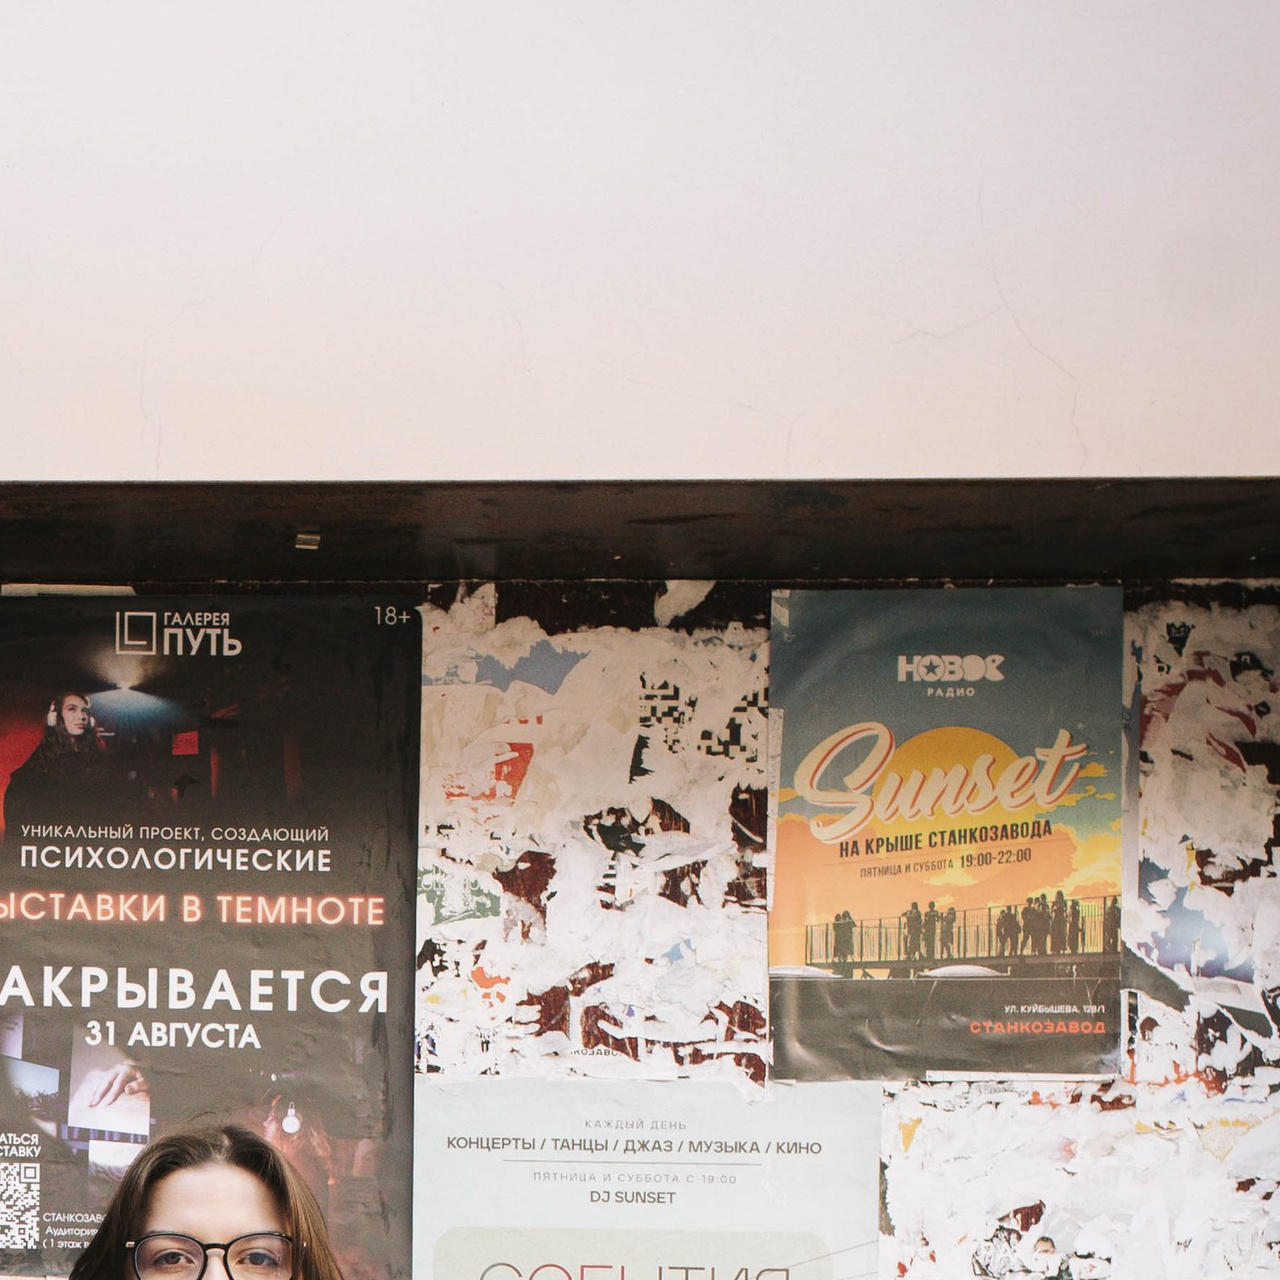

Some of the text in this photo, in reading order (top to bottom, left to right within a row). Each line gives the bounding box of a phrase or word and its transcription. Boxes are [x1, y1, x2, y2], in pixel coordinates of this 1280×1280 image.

[163, 612, 230, 626] ГАЛЕРЕЯ
[374, 606, 411, 626] 18+
[163, 628, 242, 656] ПУТЬ
[927, 687, 975, 698] РАДИО
[794, 722, 1087, 844] Sunset
[21, 823, 329, 844] УНИКАЛЬНЫЙ ПРОЕКТ, СОЗДАЮЩИЙ
[839, 820, 1052, 858] НА КРЫШЕ СТАНКОЗАВОДА
[20, 845, 331, 872] ПСИХОЛОГИЧЕСКИЕ
[860, 848, 1032, 879] ПЯТНИЦА И СУББОТА 19:00-22:00
[182, 894, 202, 922] В
[216, 896, 385, 926] ТЕМНОТЕ
[1004, 1005, 1019, 1014] УЛ.
[85, 1020, 261, 1049] 31 АВГУСТА
[970, 1021, 1106, 1034] СТАНКОЗАВОД
[584, 1118, 686, 1130] КАЖДЫЙ ДЕНЬ
[446, 1136, 536, 1151] КОНЦЕРТЫ
[551, 1138, 609, 1152] ТАНЦЫ
[623, 1139, 673, 1154] ДЖАЗ
[689, 1140, 761, 1154] МУЗЫКА
[776, 1142, 822, 1155] КИНО
[533, 1171, 737, 1184] ПЯТНИЦА И СУББОТА С 19:00
[590, 1190, 677, 1204] DJ SUNSET
